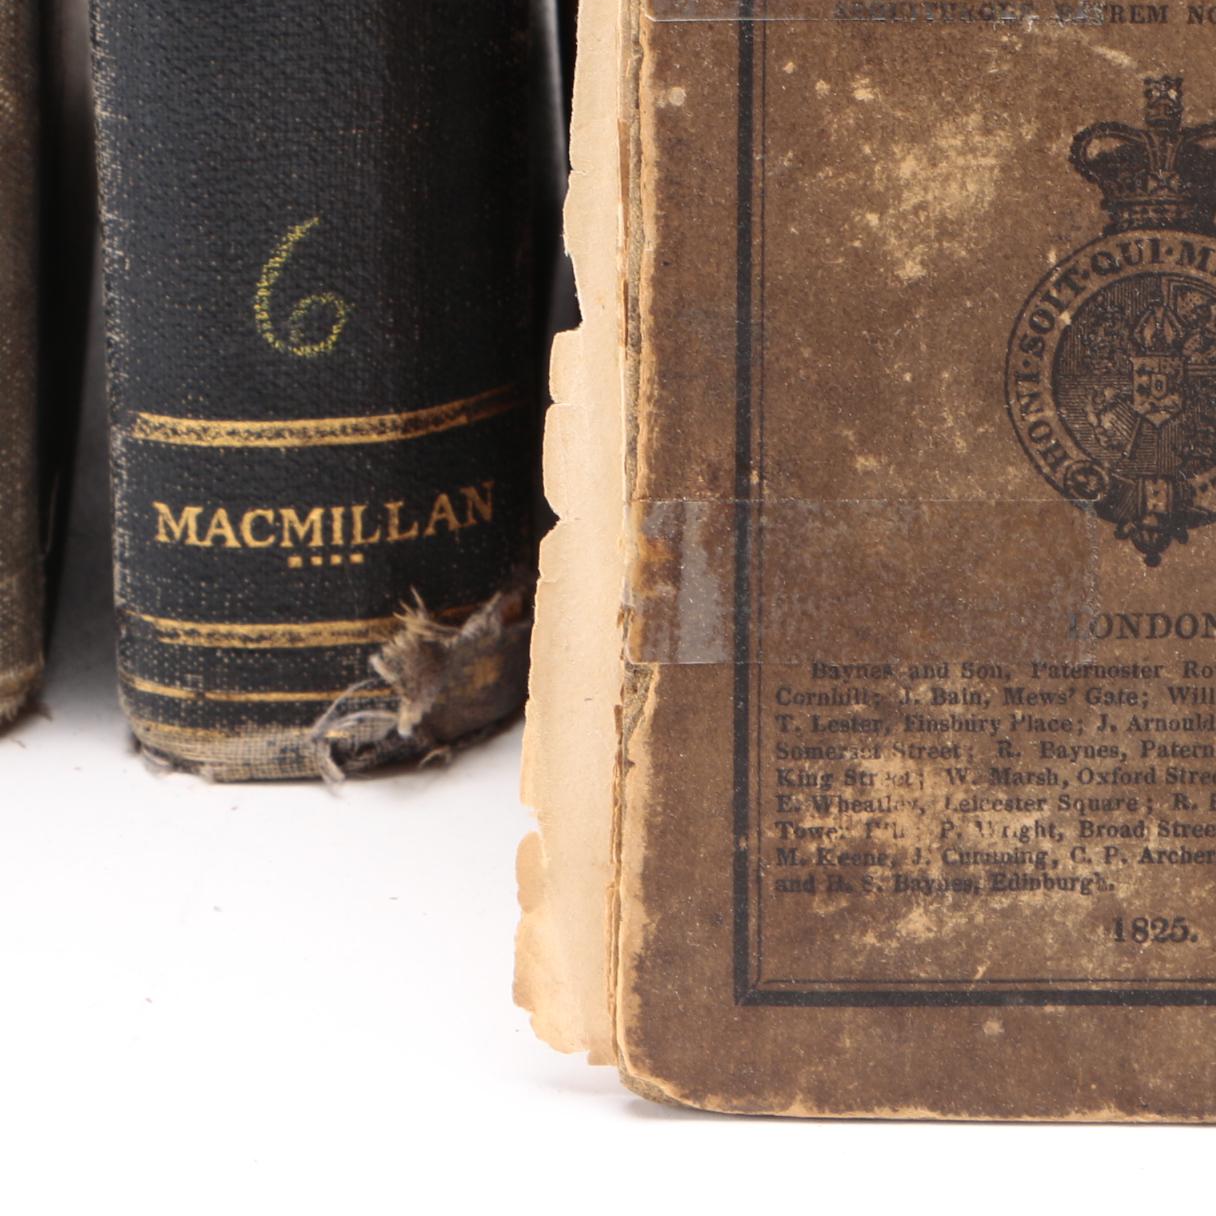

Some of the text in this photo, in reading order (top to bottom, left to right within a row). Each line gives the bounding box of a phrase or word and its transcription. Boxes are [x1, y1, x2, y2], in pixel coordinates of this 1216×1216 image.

[1053, 0, 1169, 24] PREM
[1090, 237, 1163, 276] QUI
[252, 215, 350, 359] 6
[152, 480, 496, 549] MACMILLAN
[810, 661, 896, 683] Baynes
[908, 661, 950, 681] and
[960, 660, 1012, 683] Son,
[1030, 660, 1165, 681] Paternoster
[929, 687, 992, 710] Bain,
[1083, 687, 1150, 710] Gate;
[773, 714, 803, 735] T.
[810, 713, 892, 738] Lester,
[902, 713, 1002, 737] Finsbury
[1008, 713, 1084, 736] Place;
[1096, 713, 1118, 734] J.
[996, 739, 1023, 761] R.
[1038, 739, 1129, 764] Baynes,
[775, 767, 835, 792] King
[988, 767, 1070, 790] Marsh,
[1076, 766, 1158, 786] Oxford
[1056, 793, 1154, 817] Square;
[1171, 792, 1199, 813] R.
[1077, 819, 1147, 840] Broad
[775, 846, 808, 868] M.
[1069, 845, 1093, 866] C.
[1103, 845, 1128, 866] P.
[774, 874, 816, 895] and
[990, 872, 1115, 897] Edinburgh.
[1112, 916, 1200, 947] 1825.
